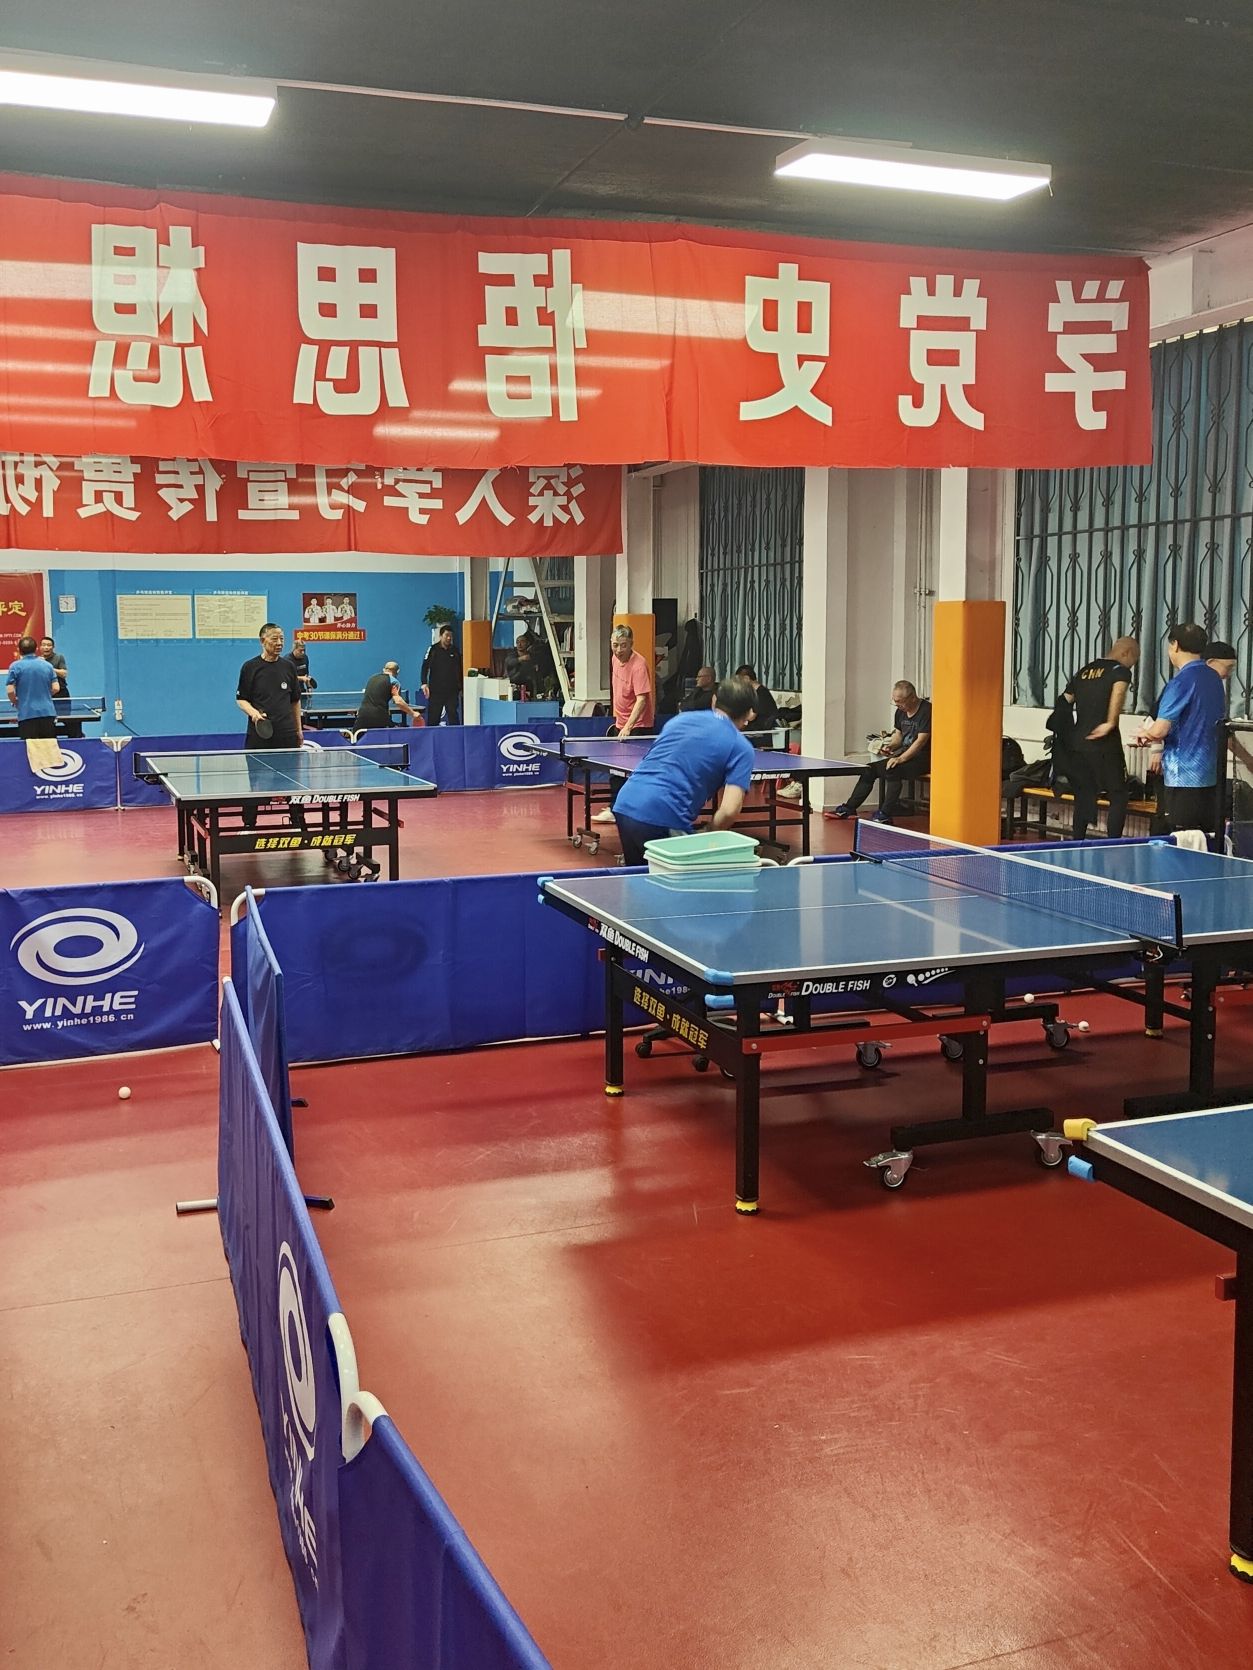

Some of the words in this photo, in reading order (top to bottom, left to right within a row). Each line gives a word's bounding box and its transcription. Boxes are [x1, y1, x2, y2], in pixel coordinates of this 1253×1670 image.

[500, 763, 541, 773] YINHE
[33, 784, 84, 795] YINHE
[312, 794, 343, 803] DOUBLE
[342, 793, 360, 802] FISH
[614, 930, 637, 956] DOUBLE
[635, 945, 650, 964] FISH
[801, 981, 846, 996] DOUBLE
[847, 979, 871, 992] FISH
[17, 990, 139, 1020] YINHE
